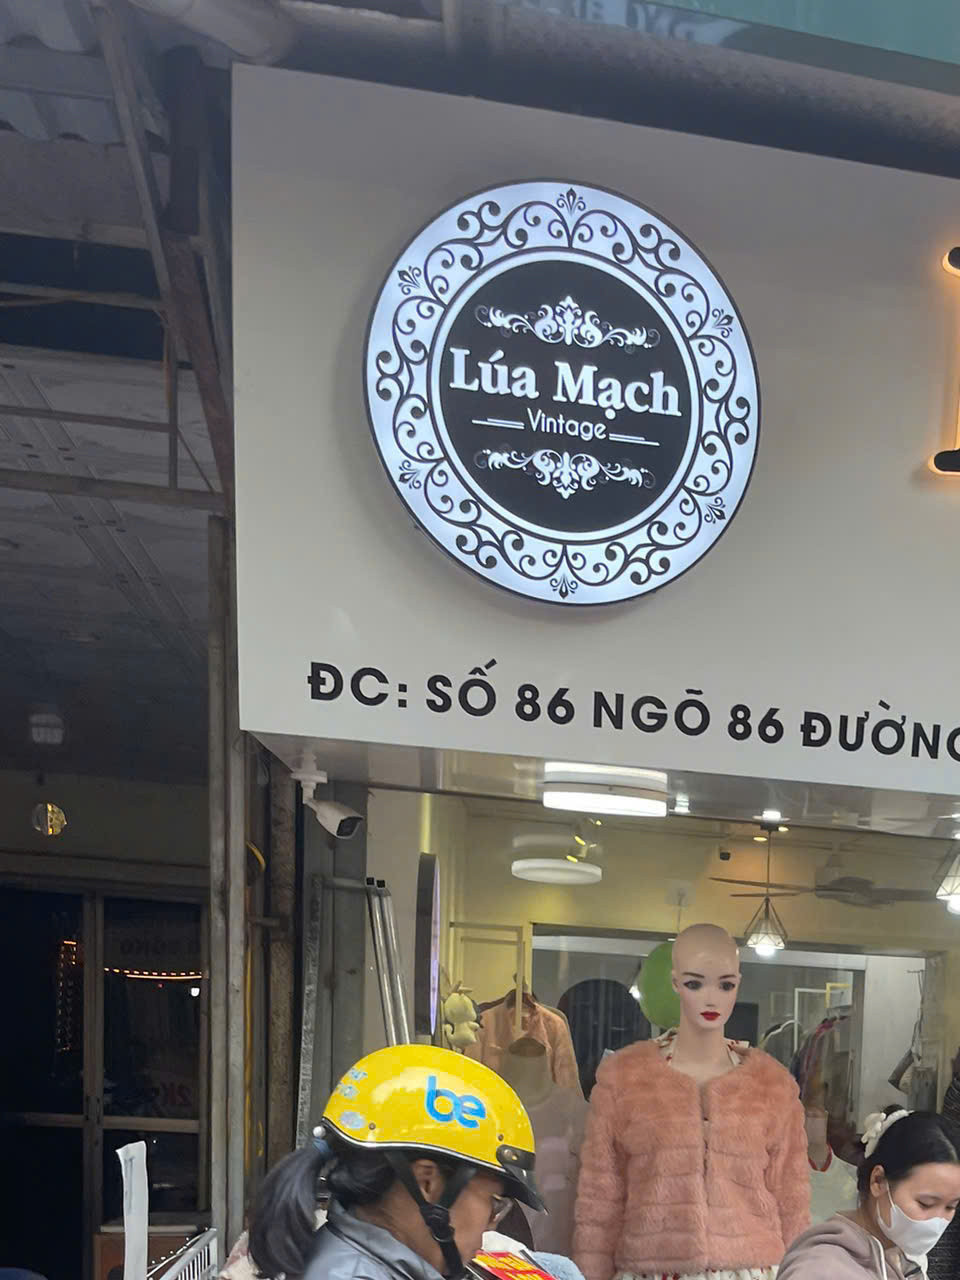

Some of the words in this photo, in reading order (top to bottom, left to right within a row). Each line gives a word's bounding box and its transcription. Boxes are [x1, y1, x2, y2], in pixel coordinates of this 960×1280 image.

[449, 347, 541, 399] Lúa
[552, 360, 682, 420] Mạch
[526, 407, 607, 442] Vintage
[307, 661, 408, 708] ĐC:
[425, 658, 497, 717] SỐ
[515, 683, 575, 725] 86
[593, 687, 711, 737] NGÕ
[727, 703, 784, 744] 86
[425, 1075, 487, 1128] be
